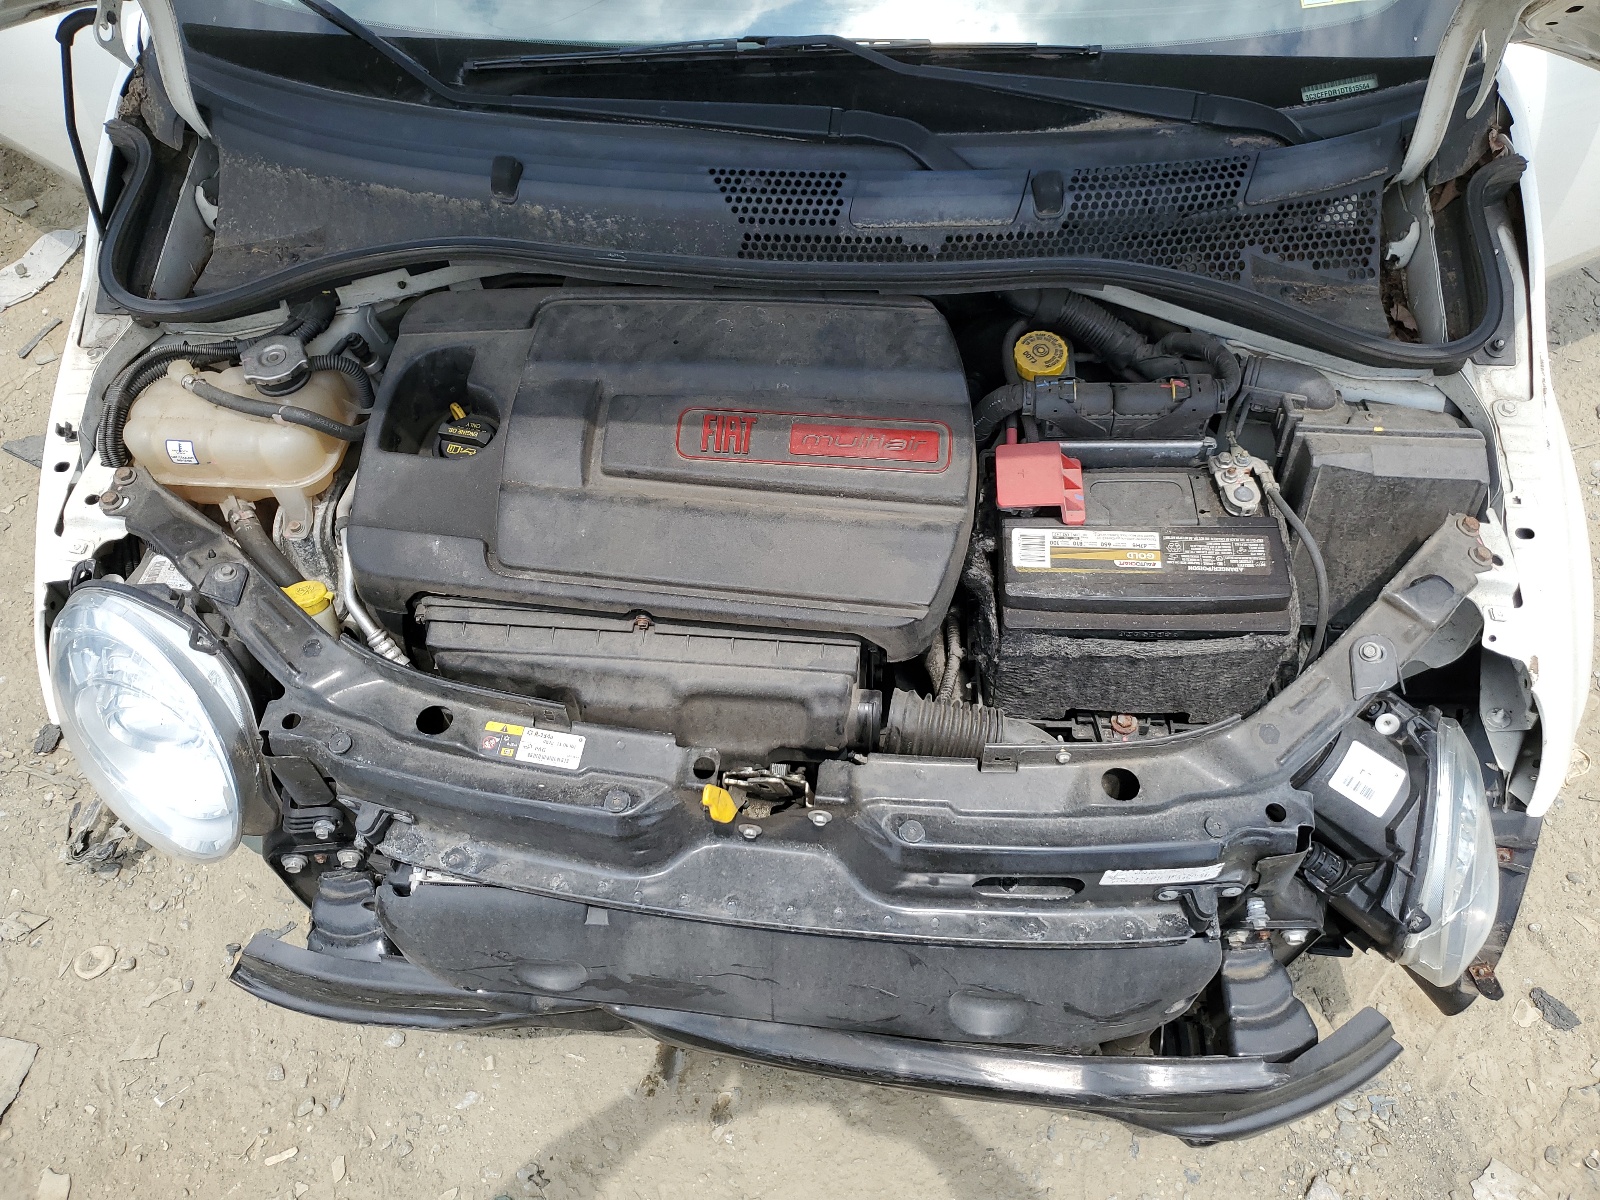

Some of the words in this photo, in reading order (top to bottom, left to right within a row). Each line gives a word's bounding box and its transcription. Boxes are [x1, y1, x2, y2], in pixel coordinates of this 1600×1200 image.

[700, 413, 758, 455] FIAT
[801, 432, 928, 452] multiair
[1126, 552, 1155, 560] GOLD
